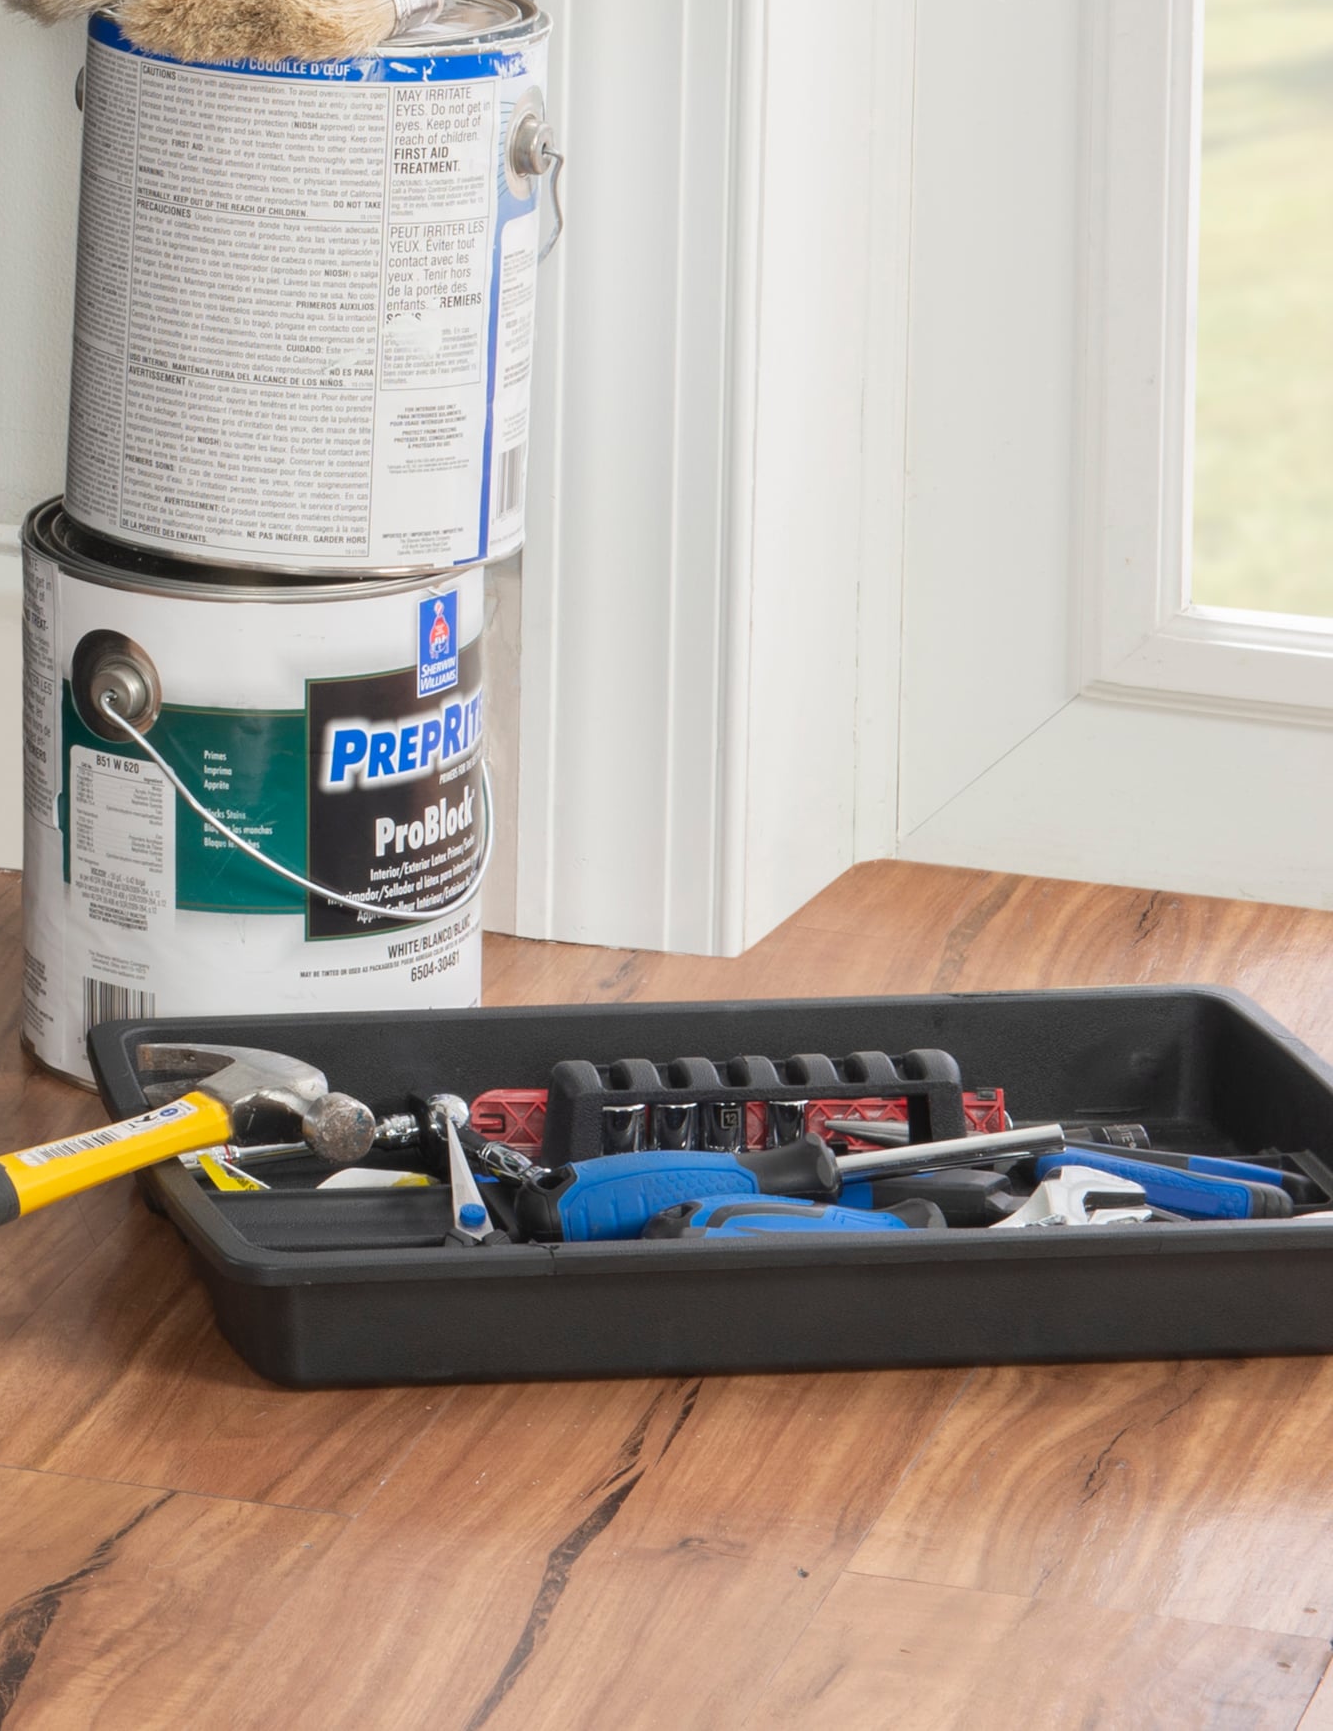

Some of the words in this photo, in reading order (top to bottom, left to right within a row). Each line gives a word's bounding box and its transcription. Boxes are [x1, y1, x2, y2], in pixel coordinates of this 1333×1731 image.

[143, 65, 177, 80] CAUTIONS
[396, 90, 422, 102] MAY
[425, 86, 472, 101] IRRITATE
[431, 103, 445, 116] Do
[448, 102, 464, 115] not
[467, 101, 481, 116] get
[426, 118, 451, 132] Keep
[454, 117, 470, 128] out
[472, 115, 481, 127] of
[172, 139, 189, 149] FIRST
[394, 133, 424, 146] reach
[428, 133, 438, 146] of
[394, 147, 427, 160] FIRST
[430, 146, 449, 159] AID
[393, 160, 461, 175] TREATMENT.
[136, 198, 192, 218] PRECAUCIONES
[173, 195, 189, 204] KEEP
[190, 197, 203, 206] OUT
[205, 199, 214, 208] OF
[216, 201, 228, 210] THE
[231, 203, 254, 213] REACH
[256, 206, 266, 214] OF
[333, 200, 344, 208] DO
[347, 201, 361, 209] NOT
[364, 201, 381, 209] TAKE
[390, 225, 420, 239] PEUT
[423, 223, 465, 238] IRRITER
[468, 220, 485, 235] LES
[426, 237, 454, 252] Éviter
[457, 237, 475, 250] tout
[388, 254, 432, 268] contact
[431, 255, 453, 266] avec
[456, 253, 469, 264] les
[423, 267, 448, 281] Tenir
[451, 267, 471, 279] hors
[387, 284, 401, 297] de
[404, 283, 413, 295] la
[416, 281, 448, 297] portée
[451, 281, 468, 293] des
[296, 301, 337, 310] PRIMEROS
[434, 292, 482, 309] REMIERS
[129, 365, 186, 386] AVERTISSEMENT
[211, 369, 235, 379] FUERA
[237, 372, 251, 381] DEL
[253, 374, 287, 385] ALCANCE
[290, 376, 299, 385] DE
[302, 377, 317, 386] LOS
[343, 368, 352, 376] ES
[354, 369, 374, 377] PARA
[162, 528, 175, 537] DES
[246, 530, 256, 539] NE
[258, 532, 273, 540] PAS
[313, 535, 344, 544] GARDER
[346, 535, 367, 544] HORS
[421, 656, 456, 678] SHERWIN
[420, 669, 457, 692] WILLIAMS
[203, 750, 227, 761] Primes
[96, 755, 111, 768] B51
[113, 758, 122, 770] W
[124, 761, 140, 774] 620
[375, 785, 473, 857] ProBlock
[243, 825, 273, 835] manchas
[411, 950, 460, 983] 6504-30481
[724, 1113, 738, 1126] 12
